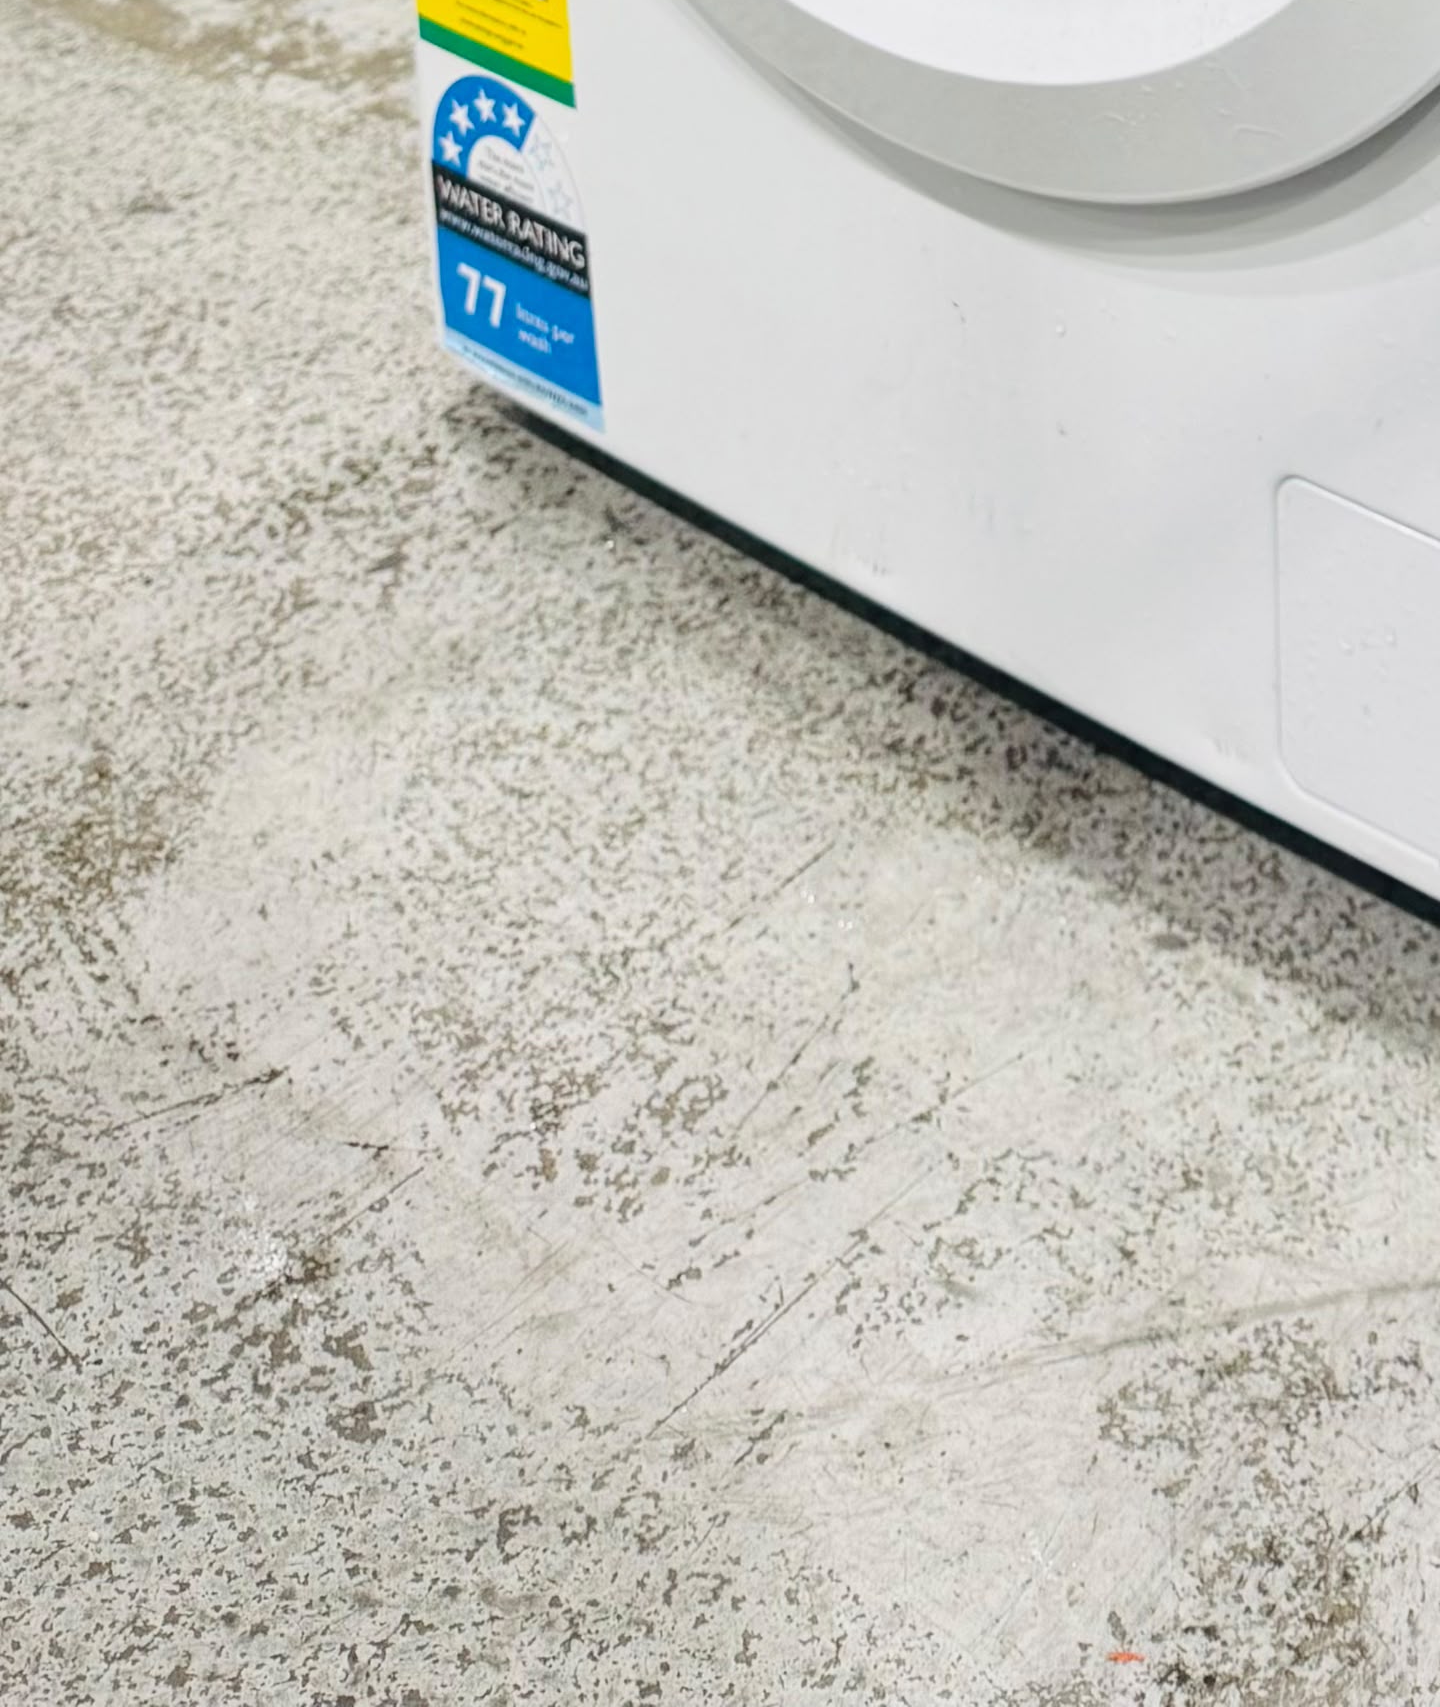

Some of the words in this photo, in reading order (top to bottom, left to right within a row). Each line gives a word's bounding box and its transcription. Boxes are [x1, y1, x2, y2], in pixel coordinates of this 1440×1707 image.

[435, 174, 506, 230] WATER
[506, 210, 586, 270] RATING
[456, 261, 507, 329] 77
[517, 328, 553, 355] wash
